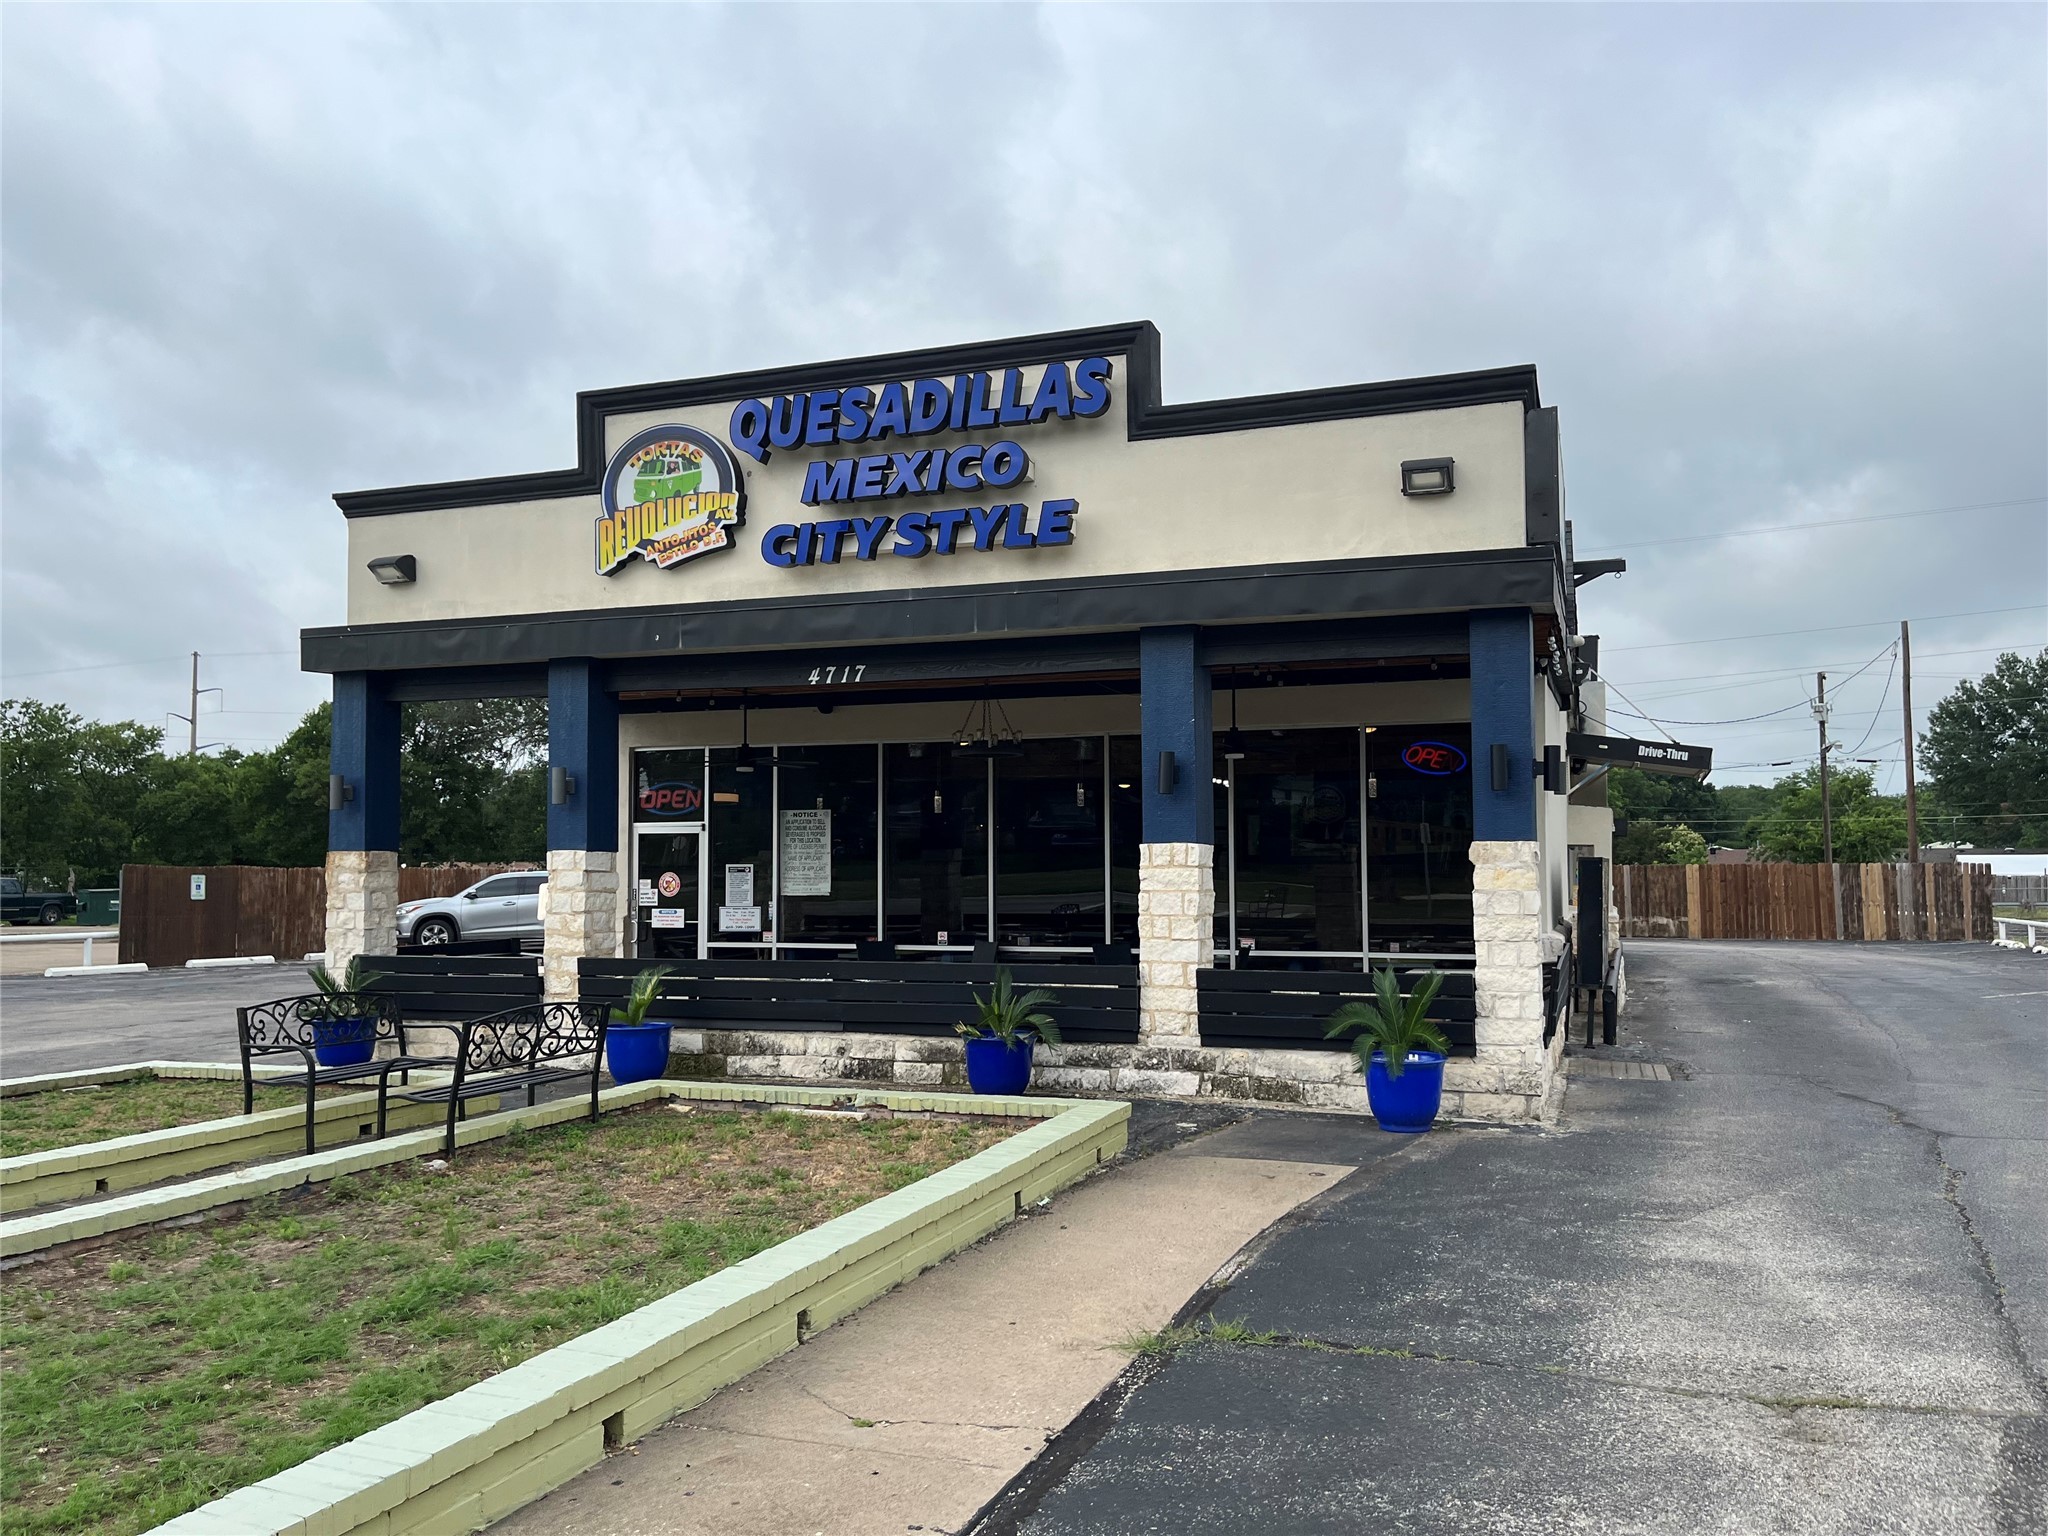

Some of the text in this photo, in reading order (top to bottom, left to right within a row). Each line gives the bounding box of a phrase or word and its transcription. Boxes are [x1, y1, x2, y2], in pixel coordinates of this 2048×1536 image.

[730, 356, 1112, 463] QUESADILLAS
[630, 441, 704, 469] TORTAS
[800, 440, 1028, 506] MEXICO
[600, 492, 736, 570] REVOLUCION
[646, 521, 717, 557] ANTOJITOS
[761, 499, 1079, 567] CITY STYLE
[657, 539, 699, 564] ESTILO
[808, 664, 867, 685] 4717
[1638, 745, 1689, 761] Drive-Thru
[640, 789, 702, 809] OPEN
